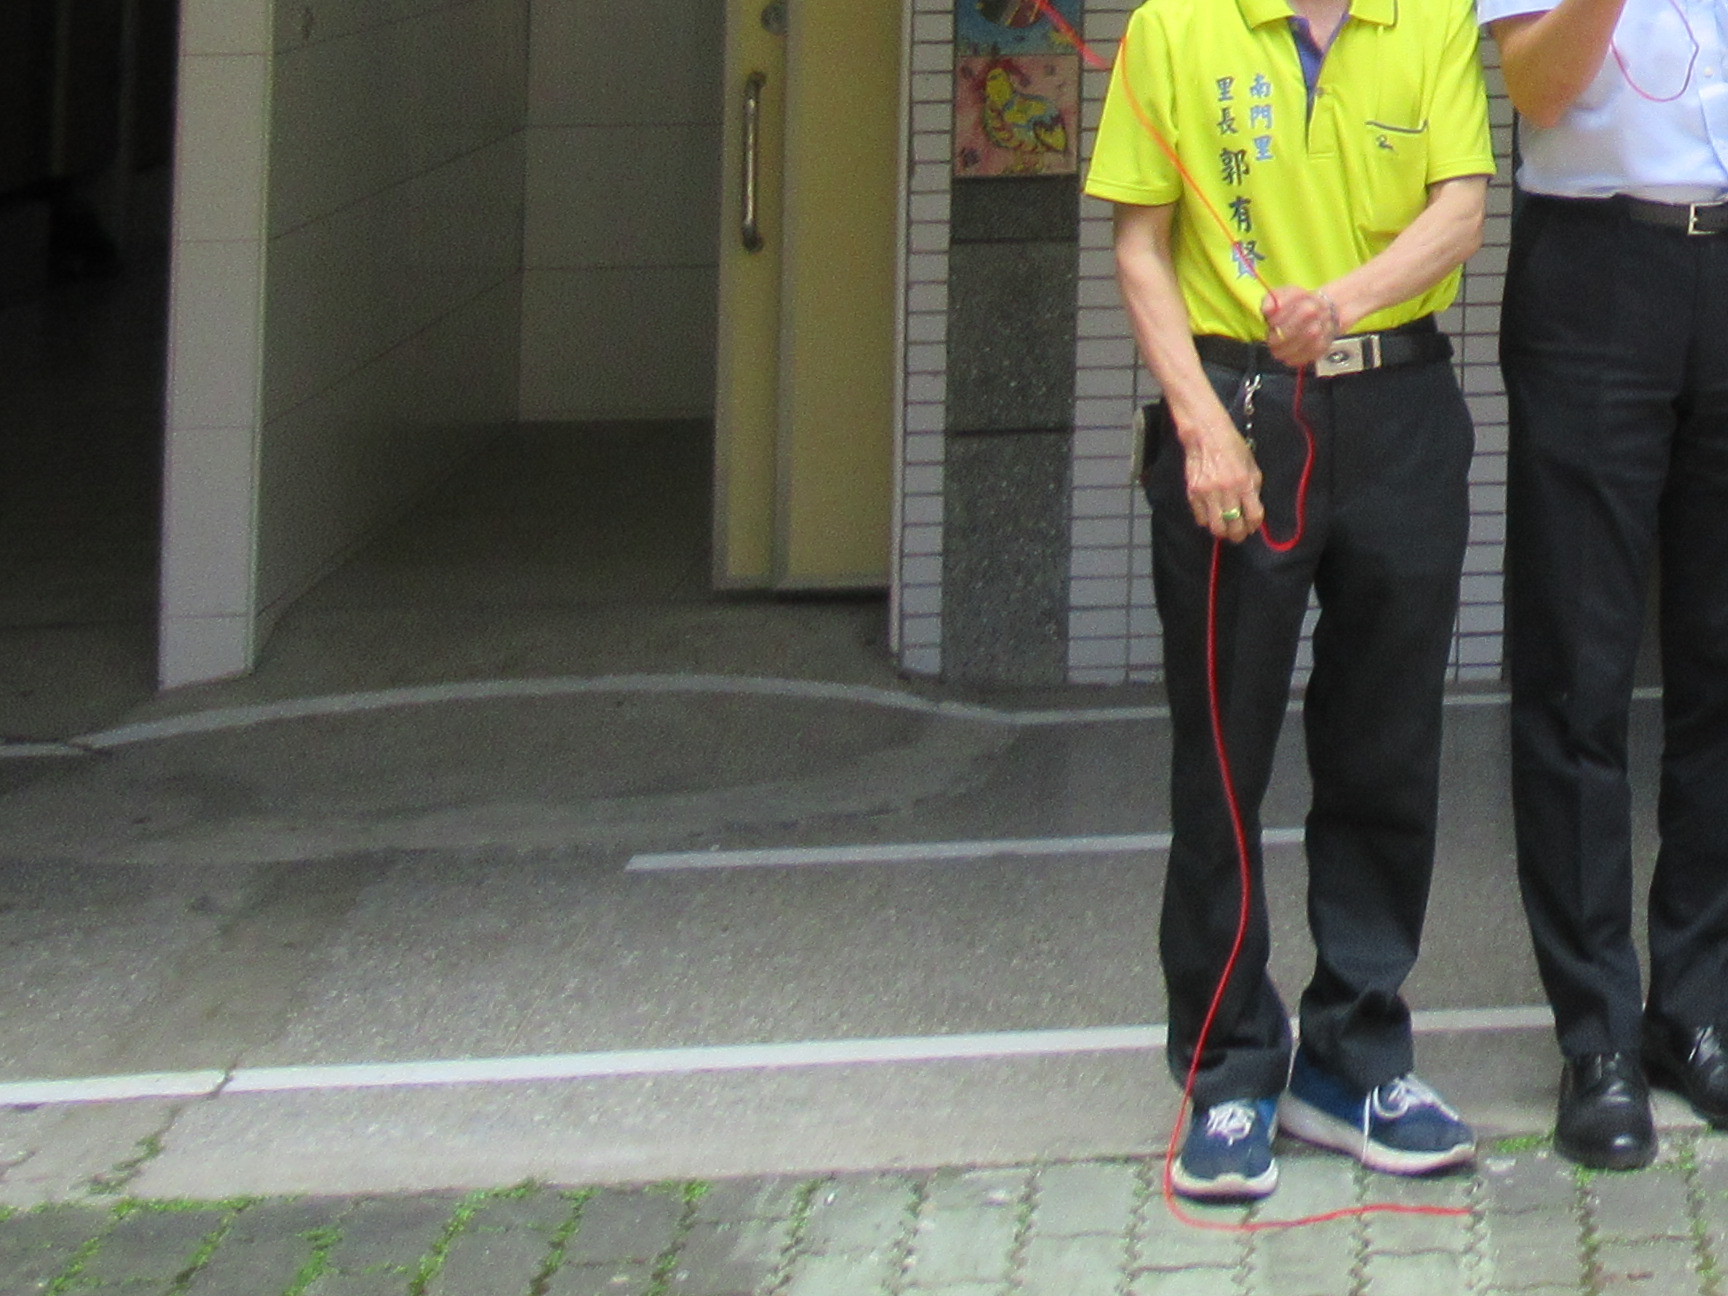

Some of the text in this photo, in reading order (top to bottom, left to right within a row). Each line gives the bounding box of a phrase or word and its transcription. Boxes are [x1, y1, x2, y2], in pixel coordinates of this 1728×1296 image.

[1216, 75, 1266, 280] 里長 郭有賢
[1249, 73, 1274, 161] 南門里
